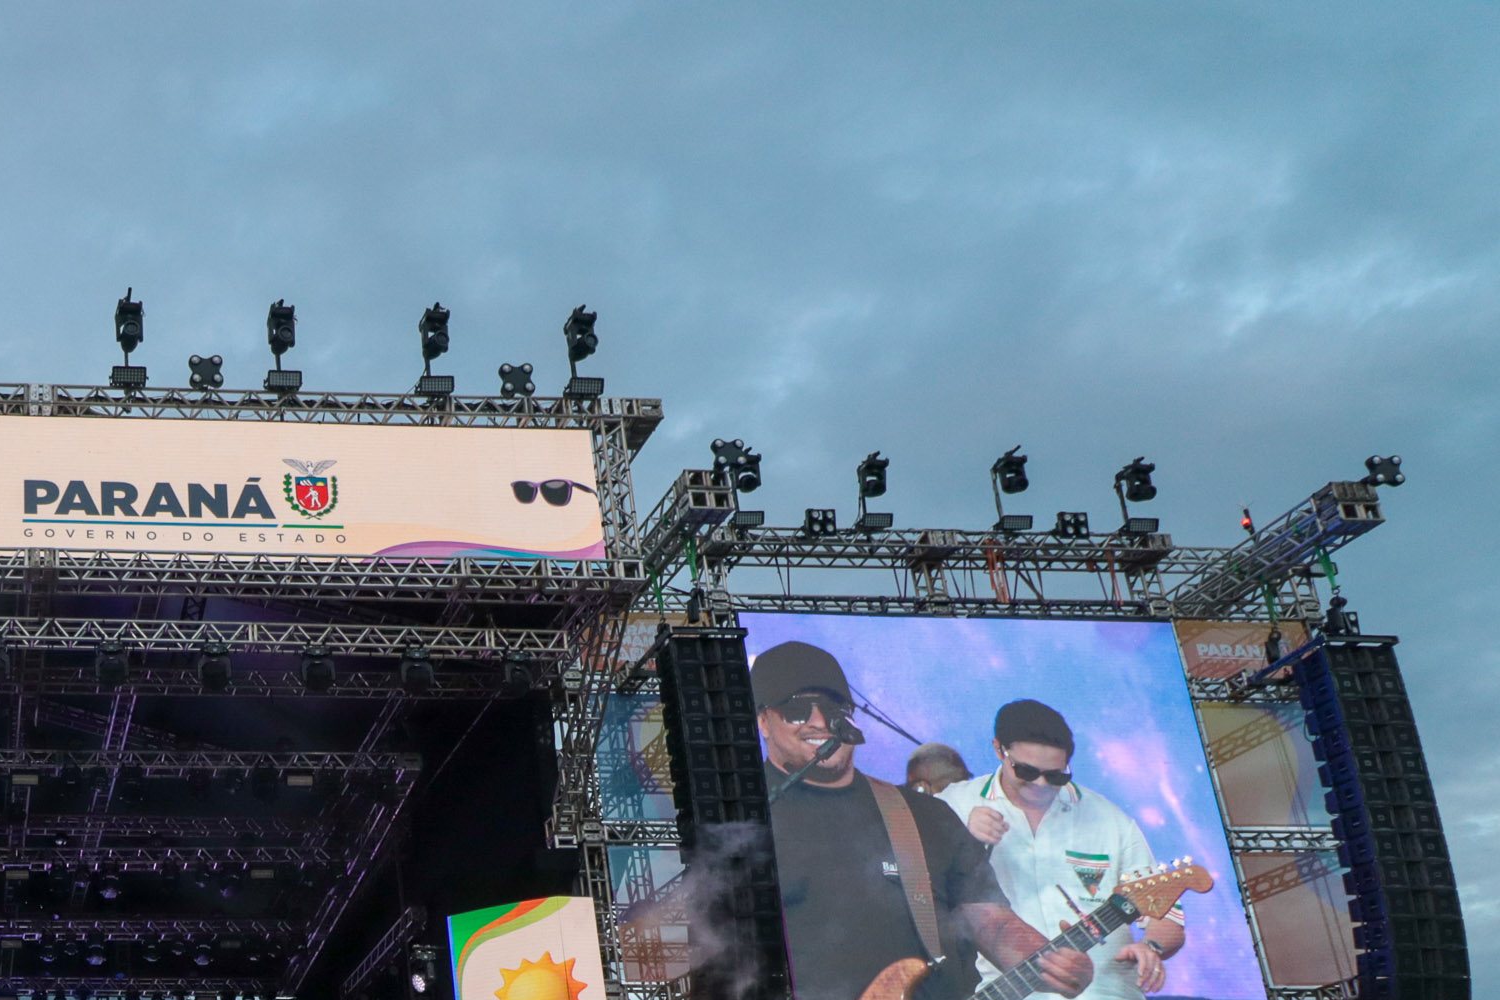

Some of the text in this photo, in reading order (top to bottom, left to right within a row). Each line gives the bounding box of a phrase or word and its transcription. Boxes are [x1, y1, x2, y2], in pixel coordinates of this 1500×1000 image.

[23, 476, 276, 519] PARANÁ
[23, 527, 347, 544] GOVERNO DO ESTADO
